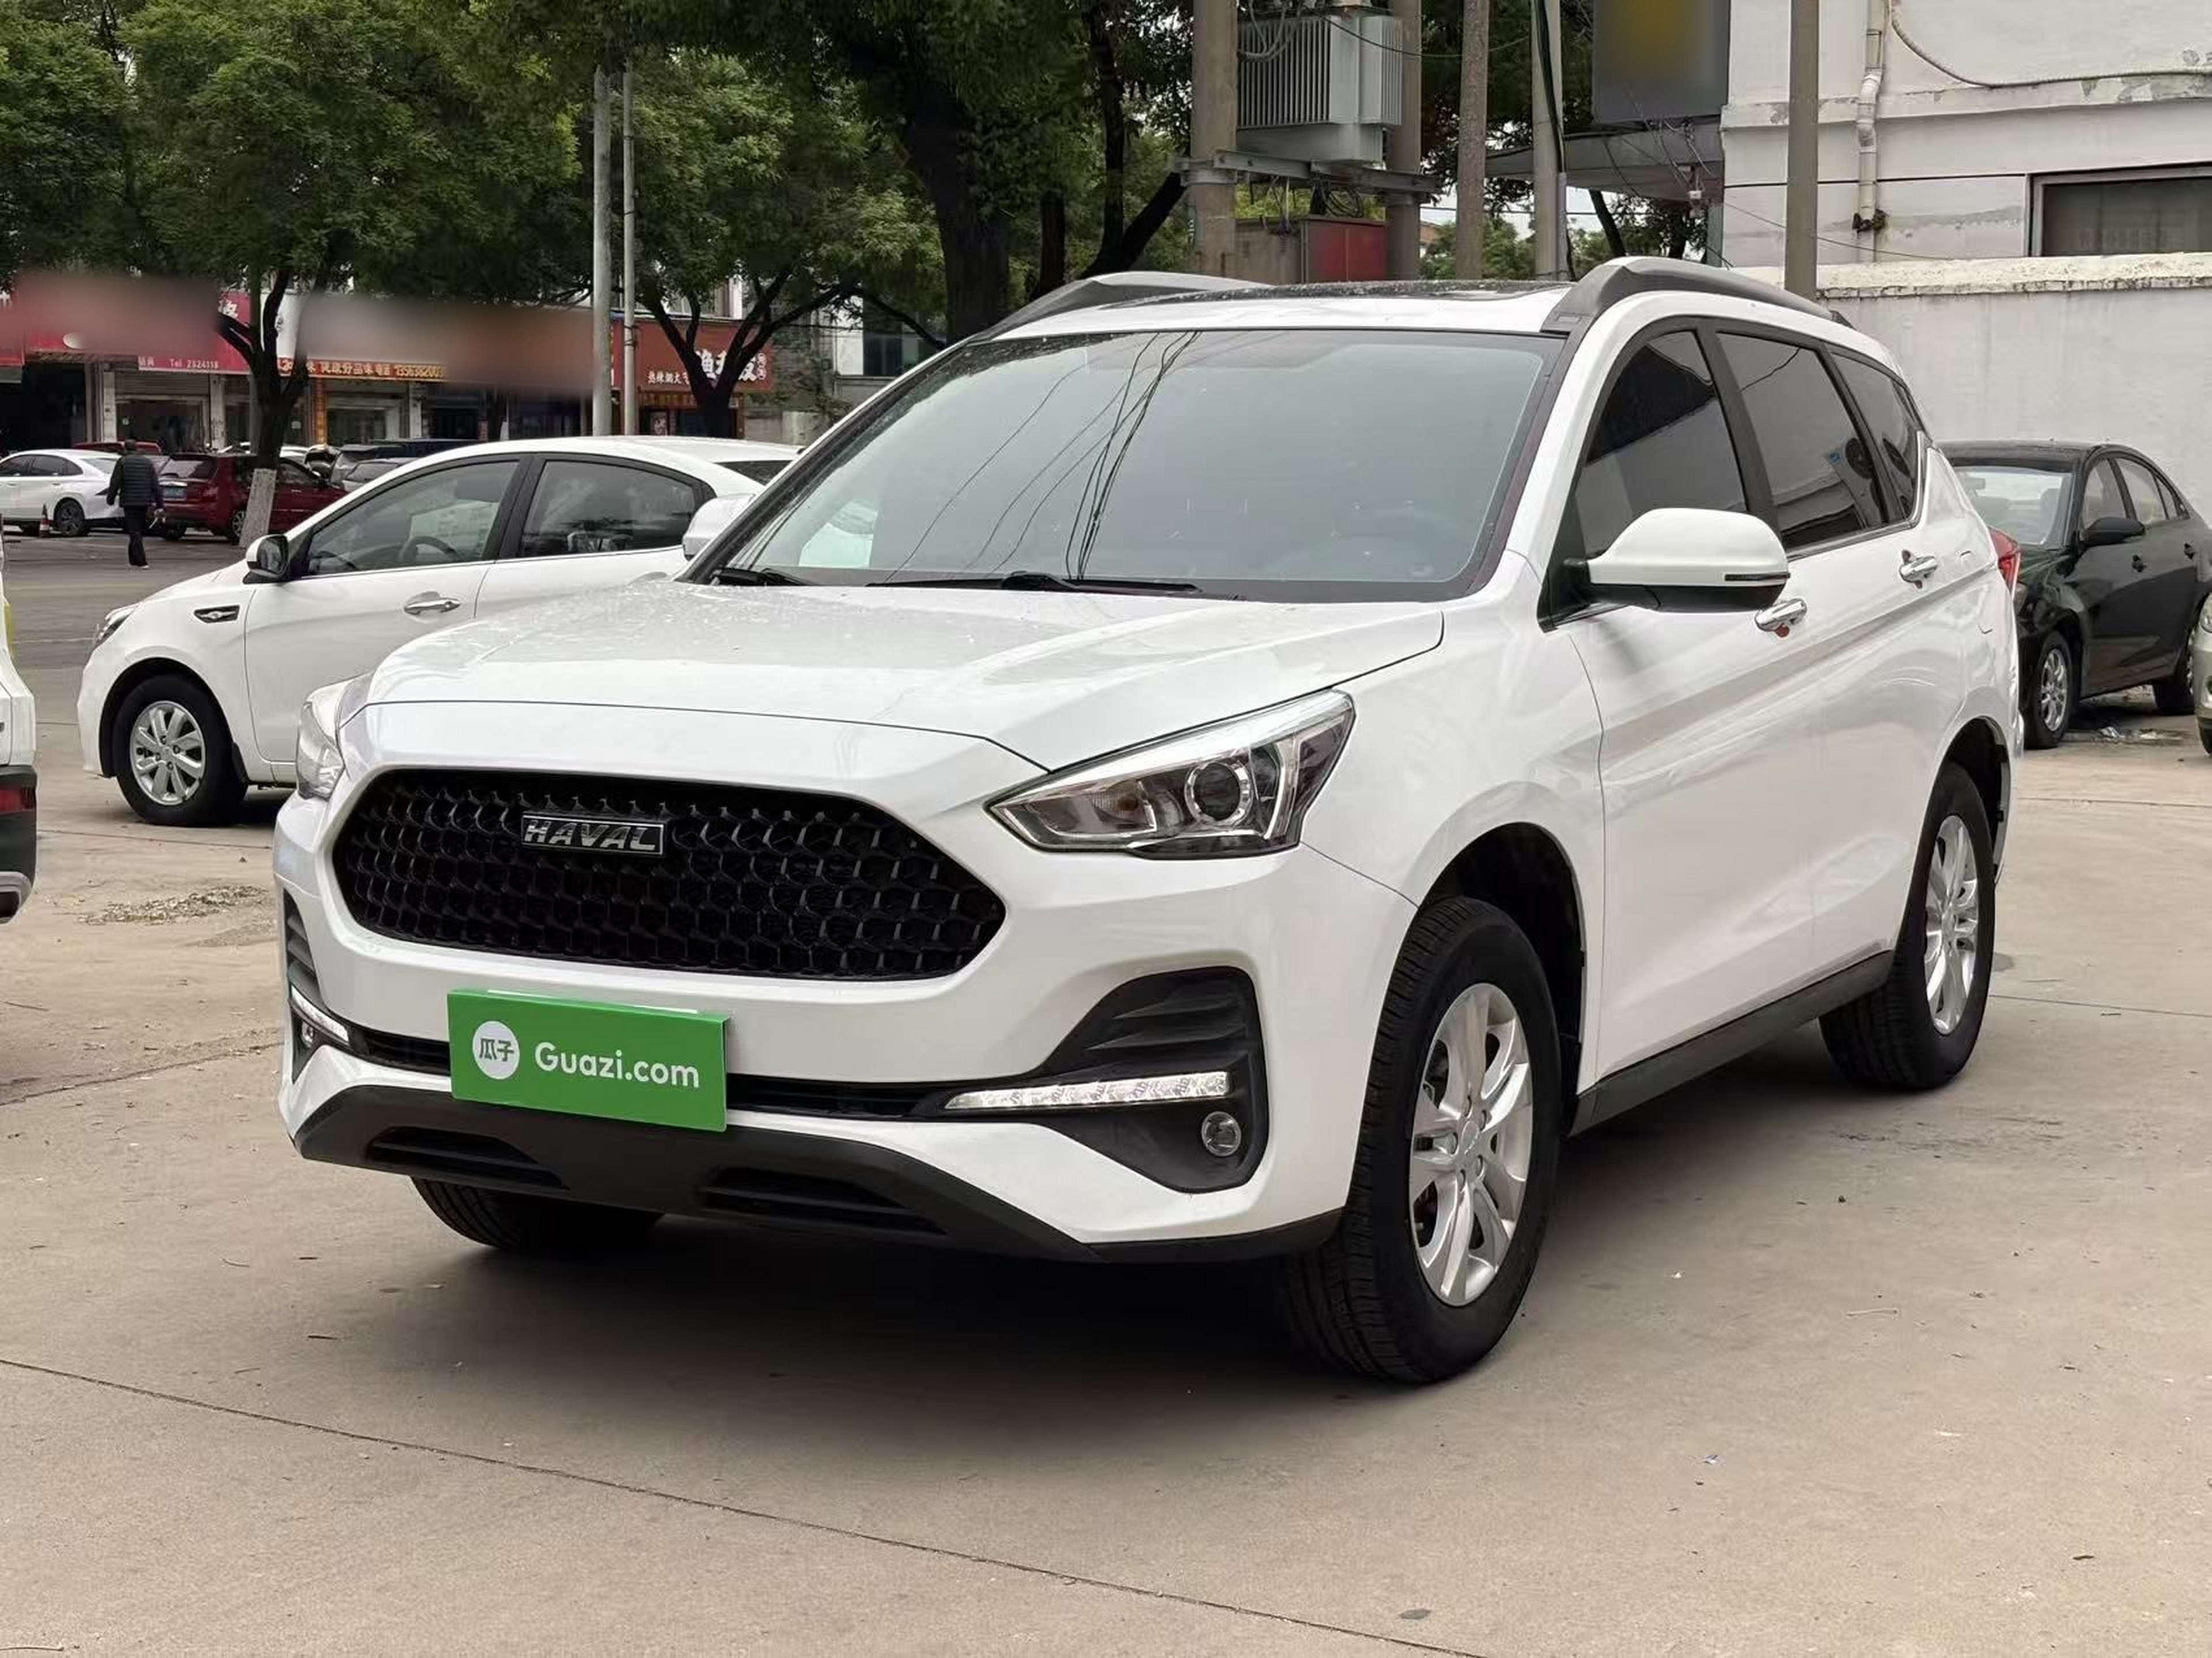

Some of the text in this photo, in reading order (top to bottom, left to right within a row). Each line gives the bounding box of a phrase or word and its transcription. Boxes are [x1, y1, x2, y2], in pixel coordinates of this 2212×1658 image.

[524, 819, 656, 851] HAVAL
[479, 1038, 514, 1062] 瓜子
[535, 1041, 699, 1088] Guazi.com
